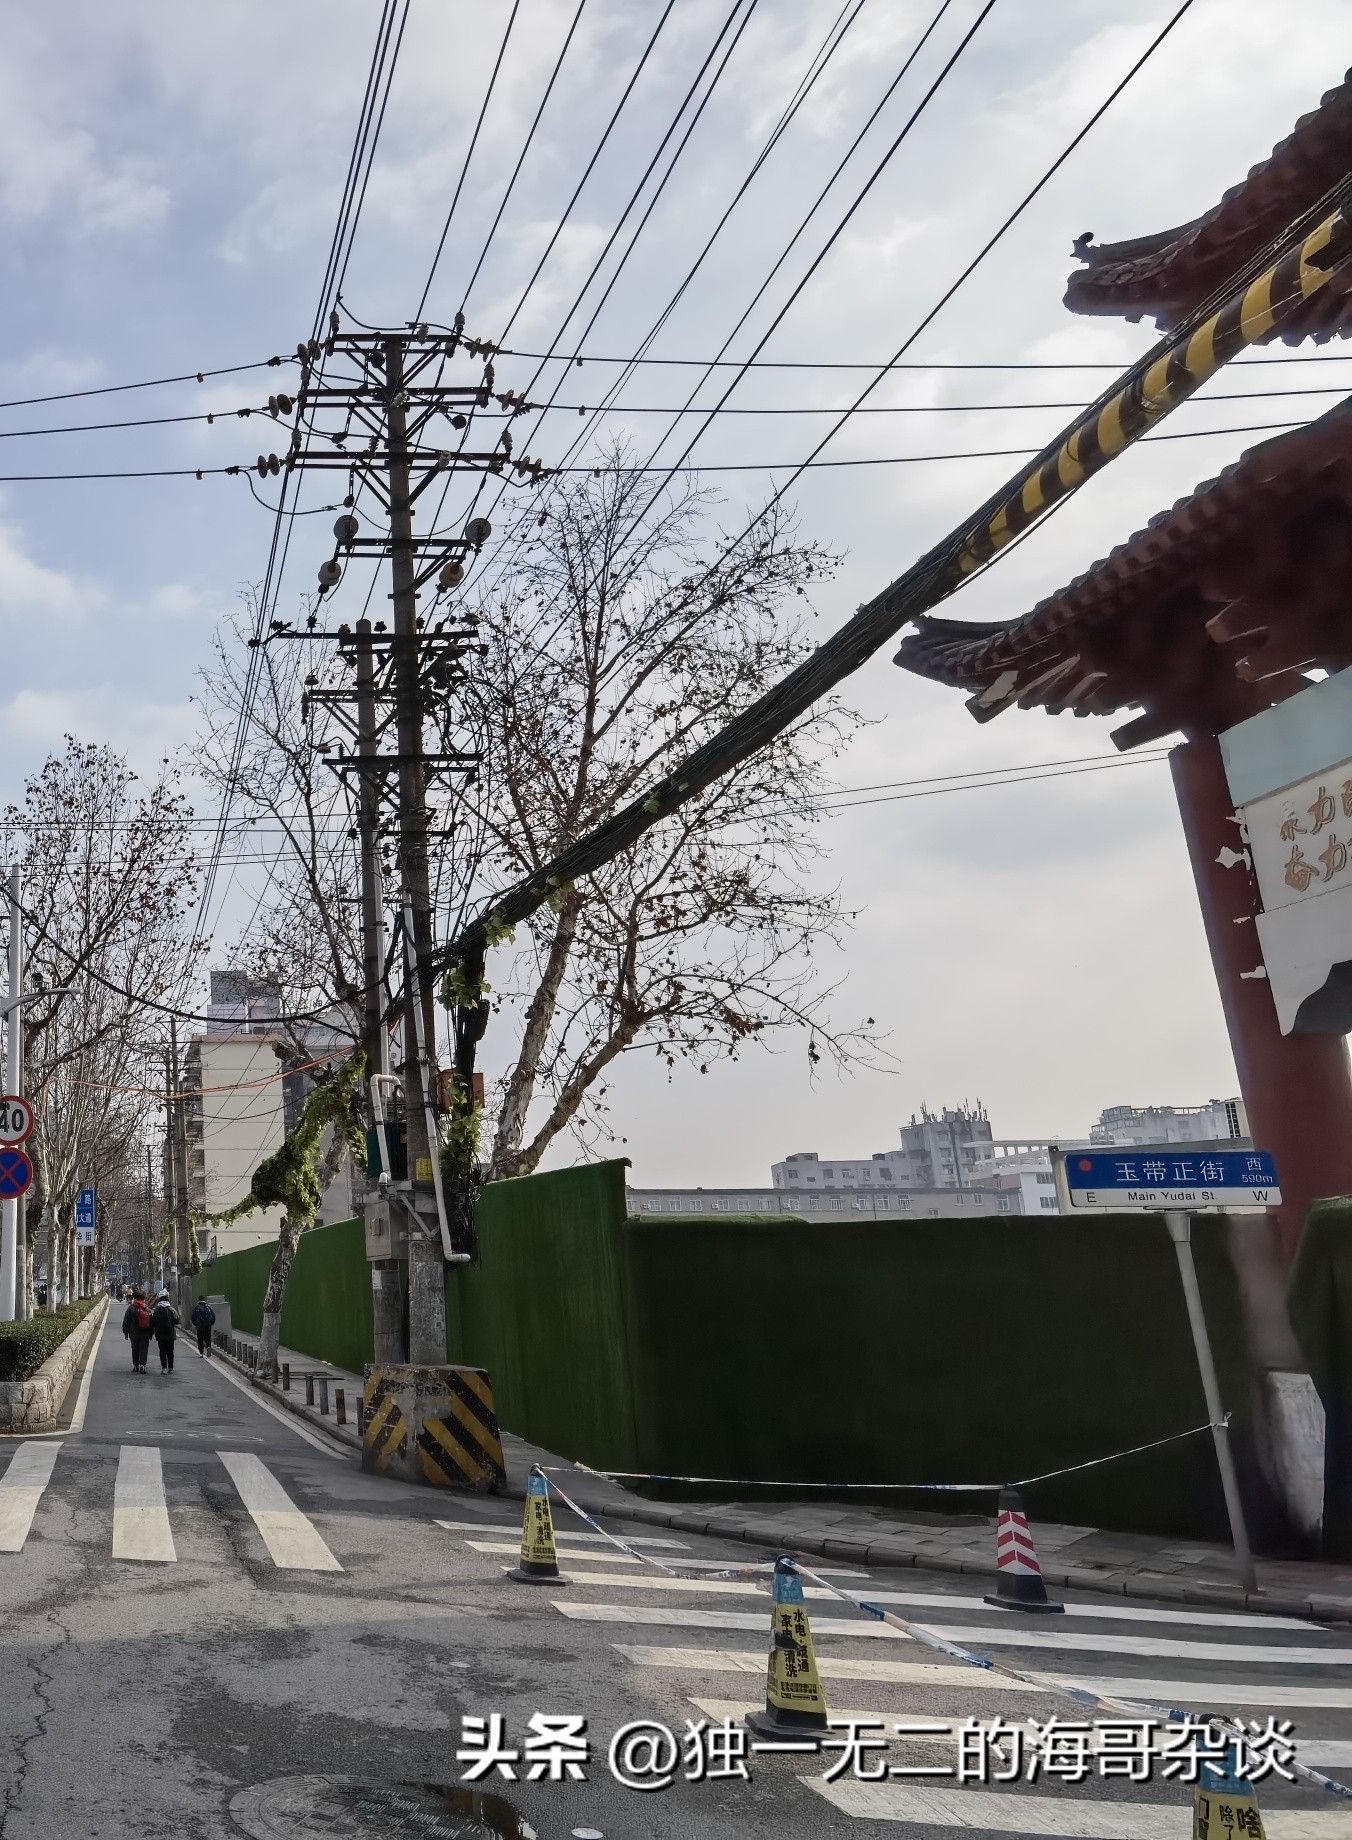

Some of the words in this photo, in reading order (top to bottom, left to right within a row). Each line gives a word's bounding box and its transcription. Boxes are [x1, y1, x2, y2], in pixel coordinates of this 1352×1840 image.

[1245, 1157, 1262, 1171] 西
[1115, 1160, 1225, 1182] 玉带正街
[1242, 1173, 1273, 1183] 590m
[1087, 1192, 1097, 1203] E
[1128, 1191, 1156, 1201] Main
[1161, 1191, 1196, 1201] Yudai
[1201, 1191, 1215, 1201] St
[1253, 1190, 1268, 1202] W
